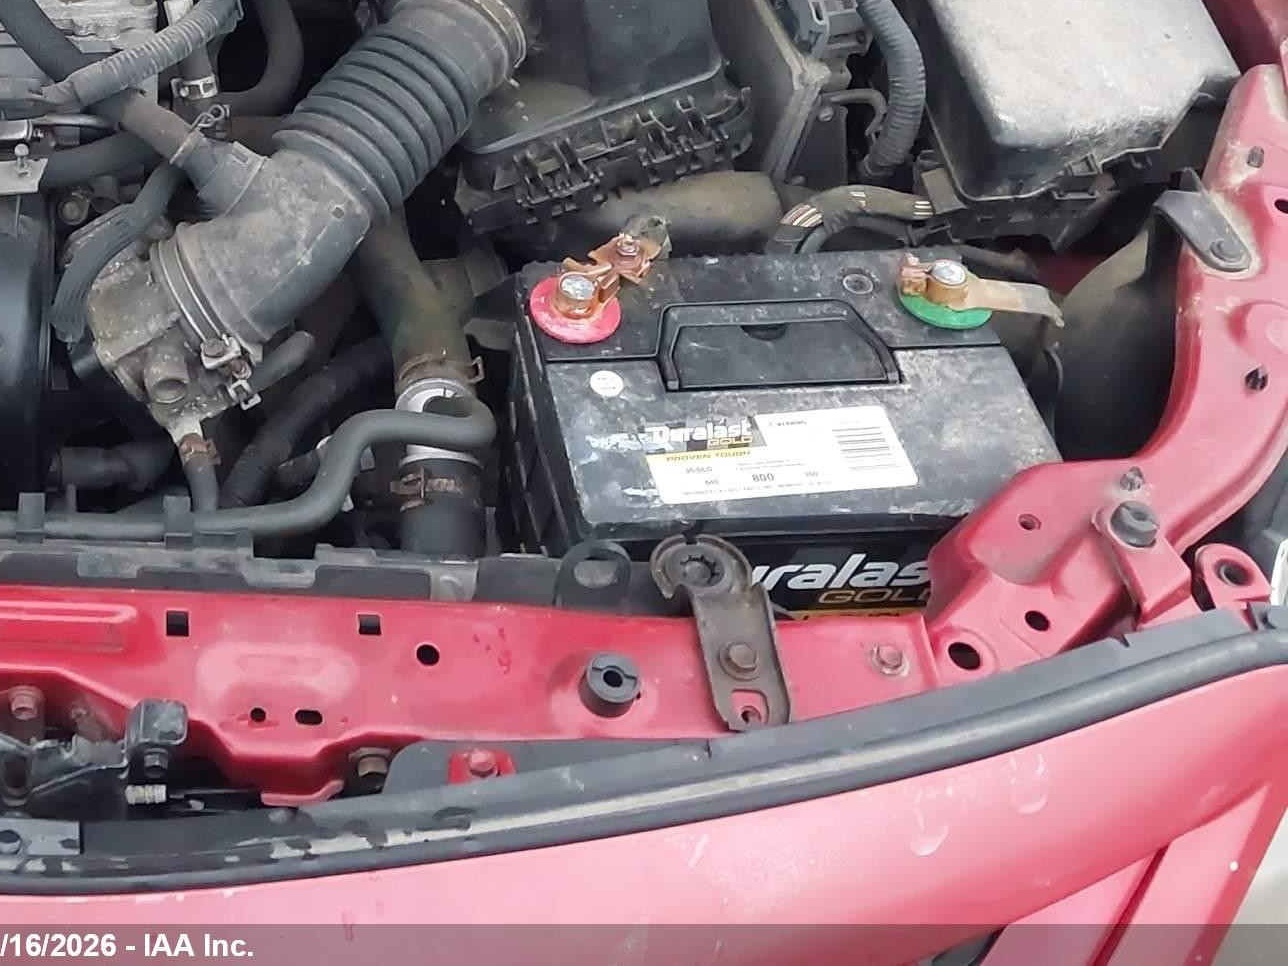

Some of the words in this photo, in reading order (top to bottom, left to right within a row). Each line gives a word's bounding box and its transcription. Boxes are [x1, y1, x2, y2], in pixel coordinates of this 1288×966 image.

[707, 436, 753, 446] GOLD
[666, 453, 711, 462] PROVEN
[714, 450, 752, 459] TOUGH
[752, 472, 775, 483] 800
